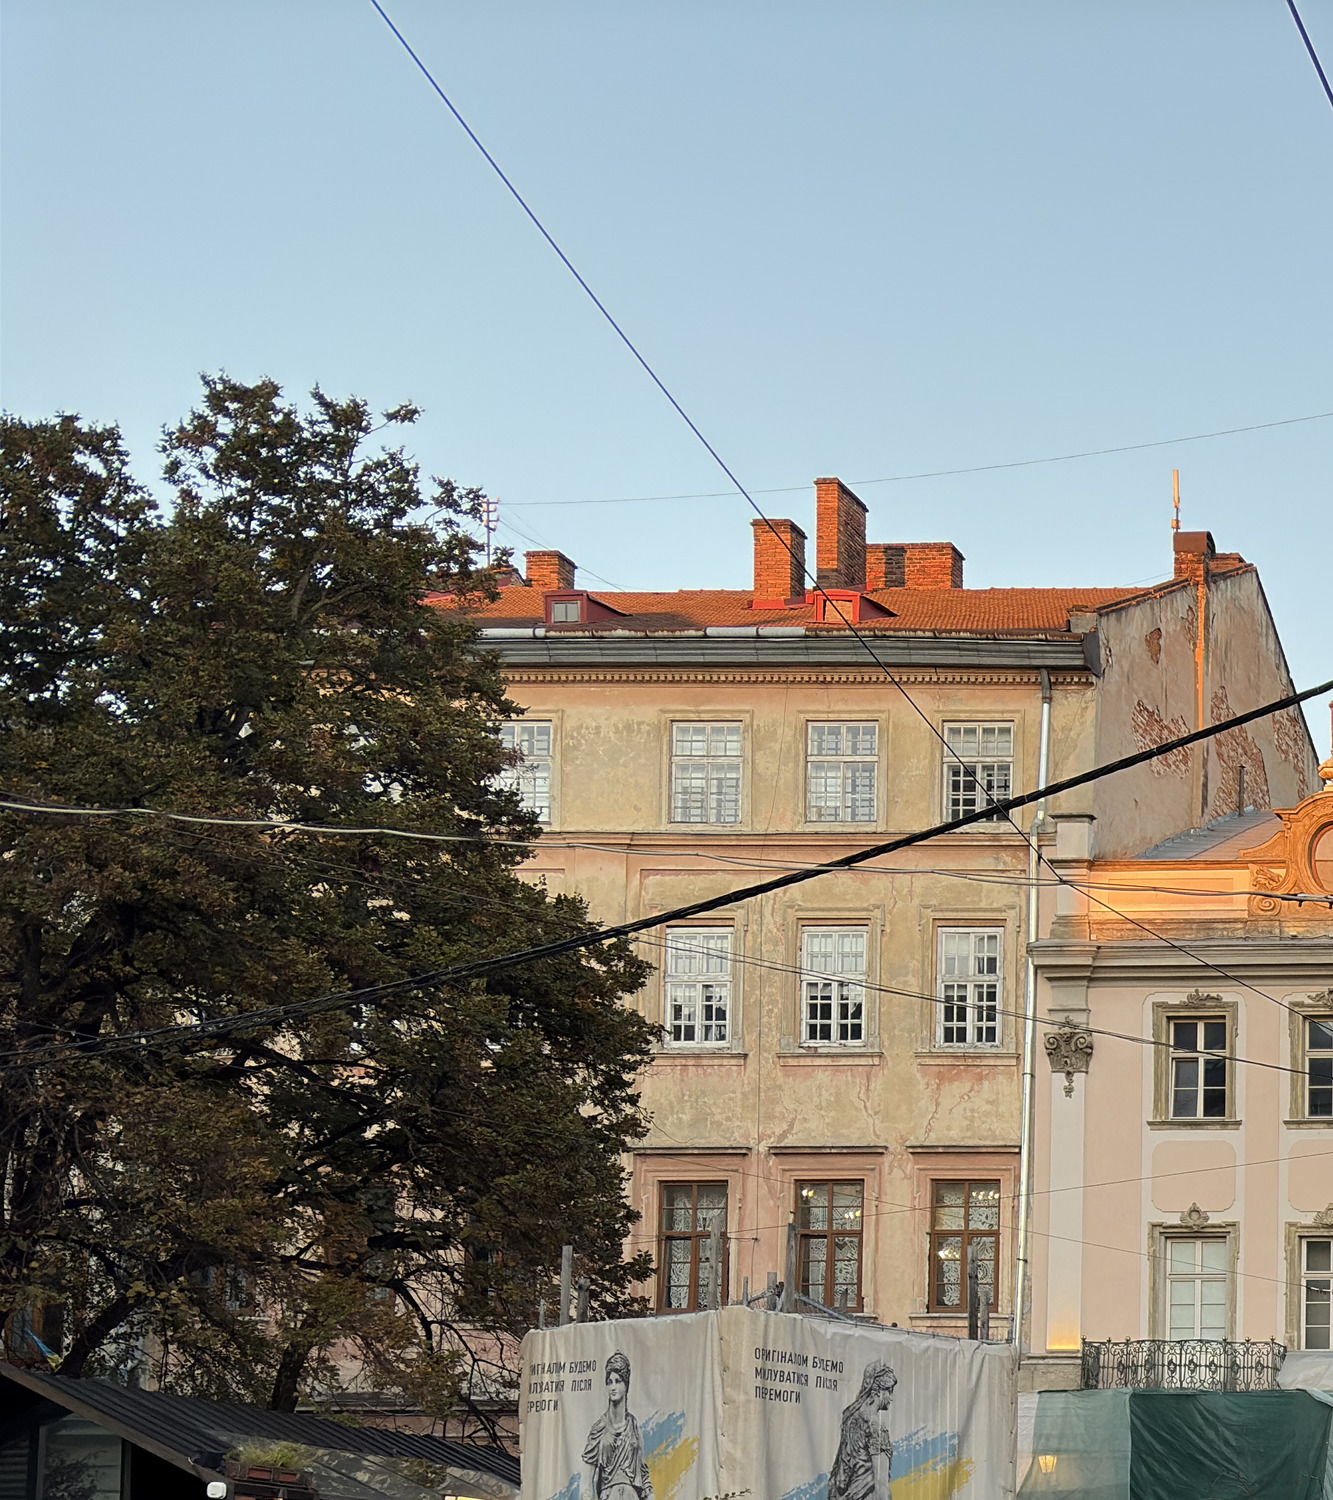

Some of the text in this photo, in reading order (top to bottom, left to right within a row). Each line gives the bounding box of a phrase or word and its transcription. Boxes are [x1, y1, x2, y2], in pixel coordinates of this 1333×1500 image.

[568, 1359, 597, 1374] БУДЕМО
[754, 1347, 844, 1374] ОРИГІНАЛОМ БУДЕМО
[570, 1378, 593, 1393] ПІСЛЯ
[754, 1366, 838, 1392] МИЛУВАТИСЯ ПІСЛЯ
[754, 1386, 801, 1404] ПЕРЕМОГИ
